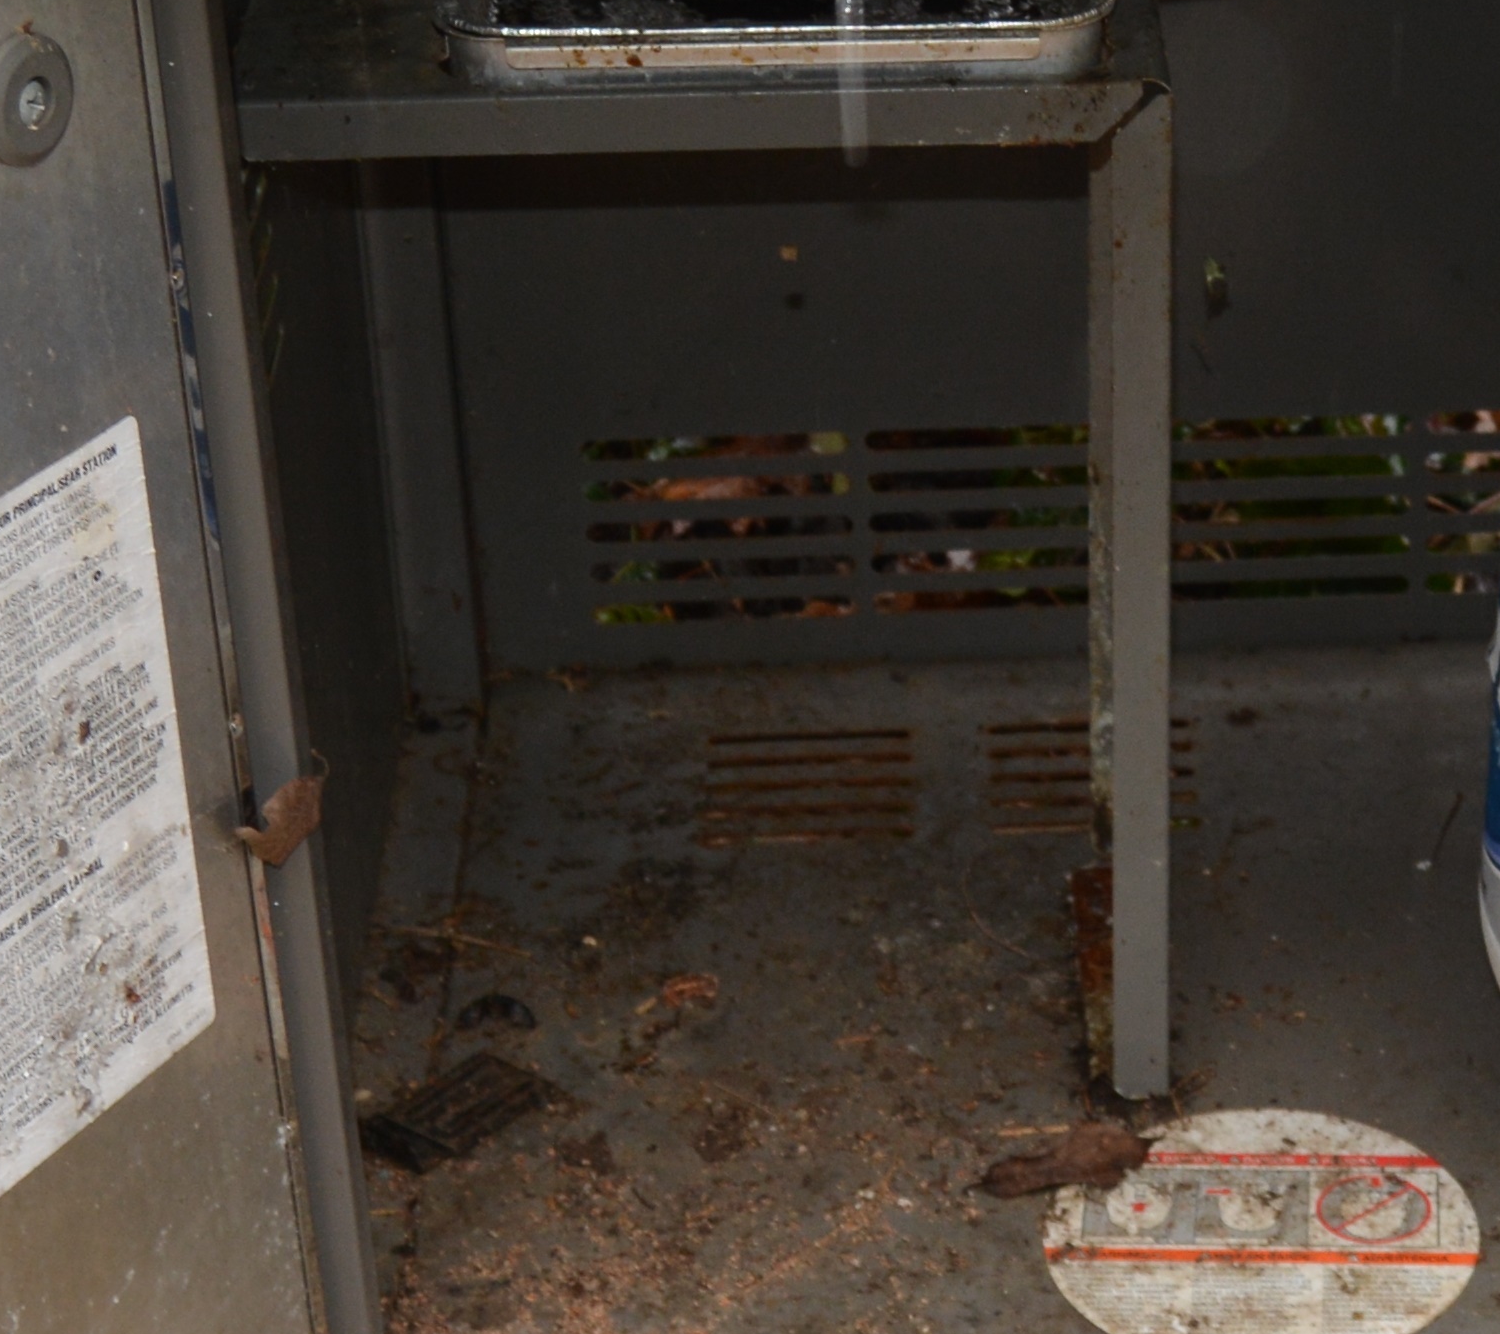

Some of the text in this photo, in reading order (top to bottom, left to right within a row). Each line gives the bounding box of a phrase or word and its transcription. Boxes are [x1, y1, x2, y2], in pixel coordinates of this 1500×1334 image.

[82, 442, 117, 476] STATION
[143, 695, 158, 715] UNE
[108, 740, 139, 771] PRODUIT
[141, 728, 155, 748] PAS
[16, 912, 29, 931] DU
